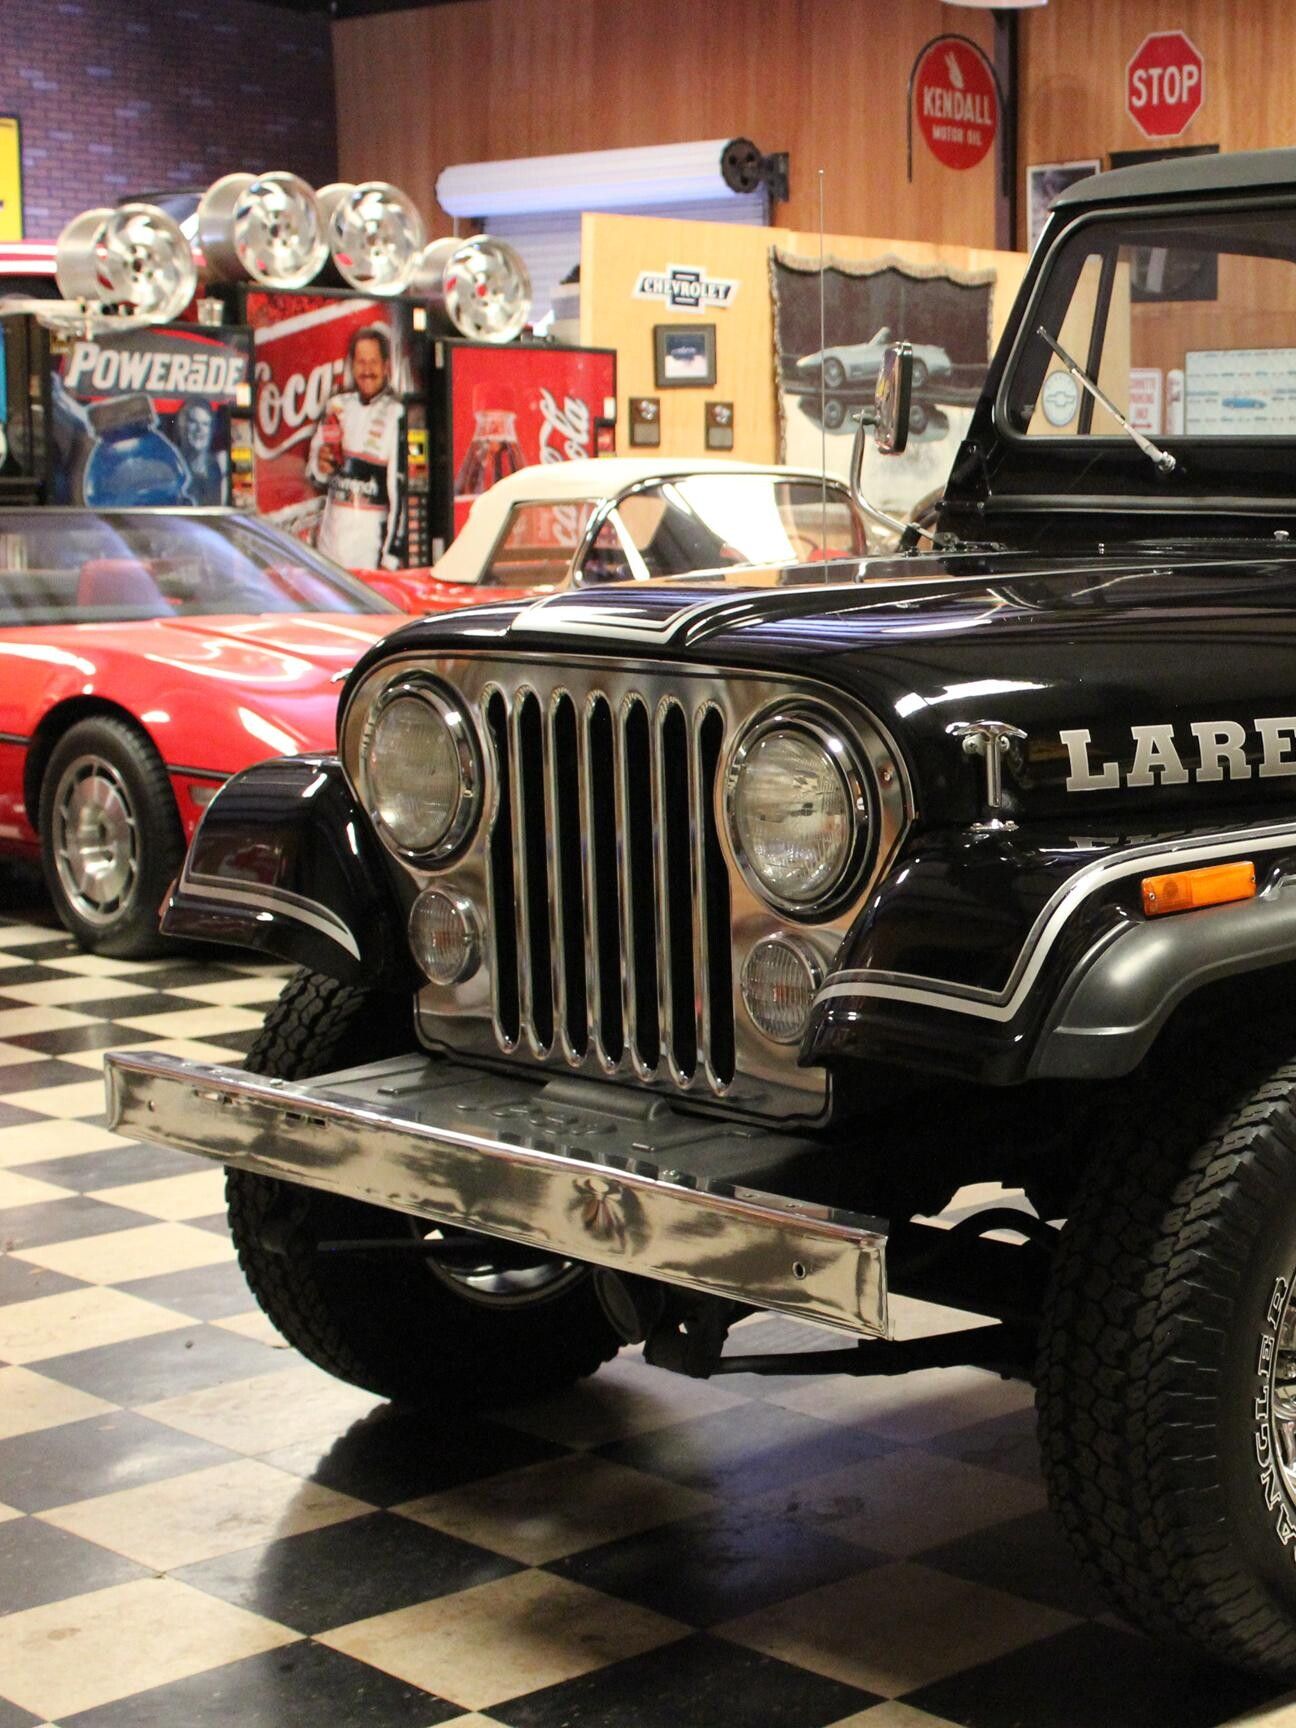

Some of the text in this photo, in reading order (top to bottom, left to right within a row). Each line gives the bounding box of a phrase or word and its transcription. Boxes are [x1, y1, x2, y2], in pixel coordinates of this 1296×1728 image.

[1131, 64, 1199, 108] STOP
[922, 85, 992, 125] KENDALL
[932, 124, 983, 146] MOTOR OIL
[643, 276, 727, 300] CHEVROLET
